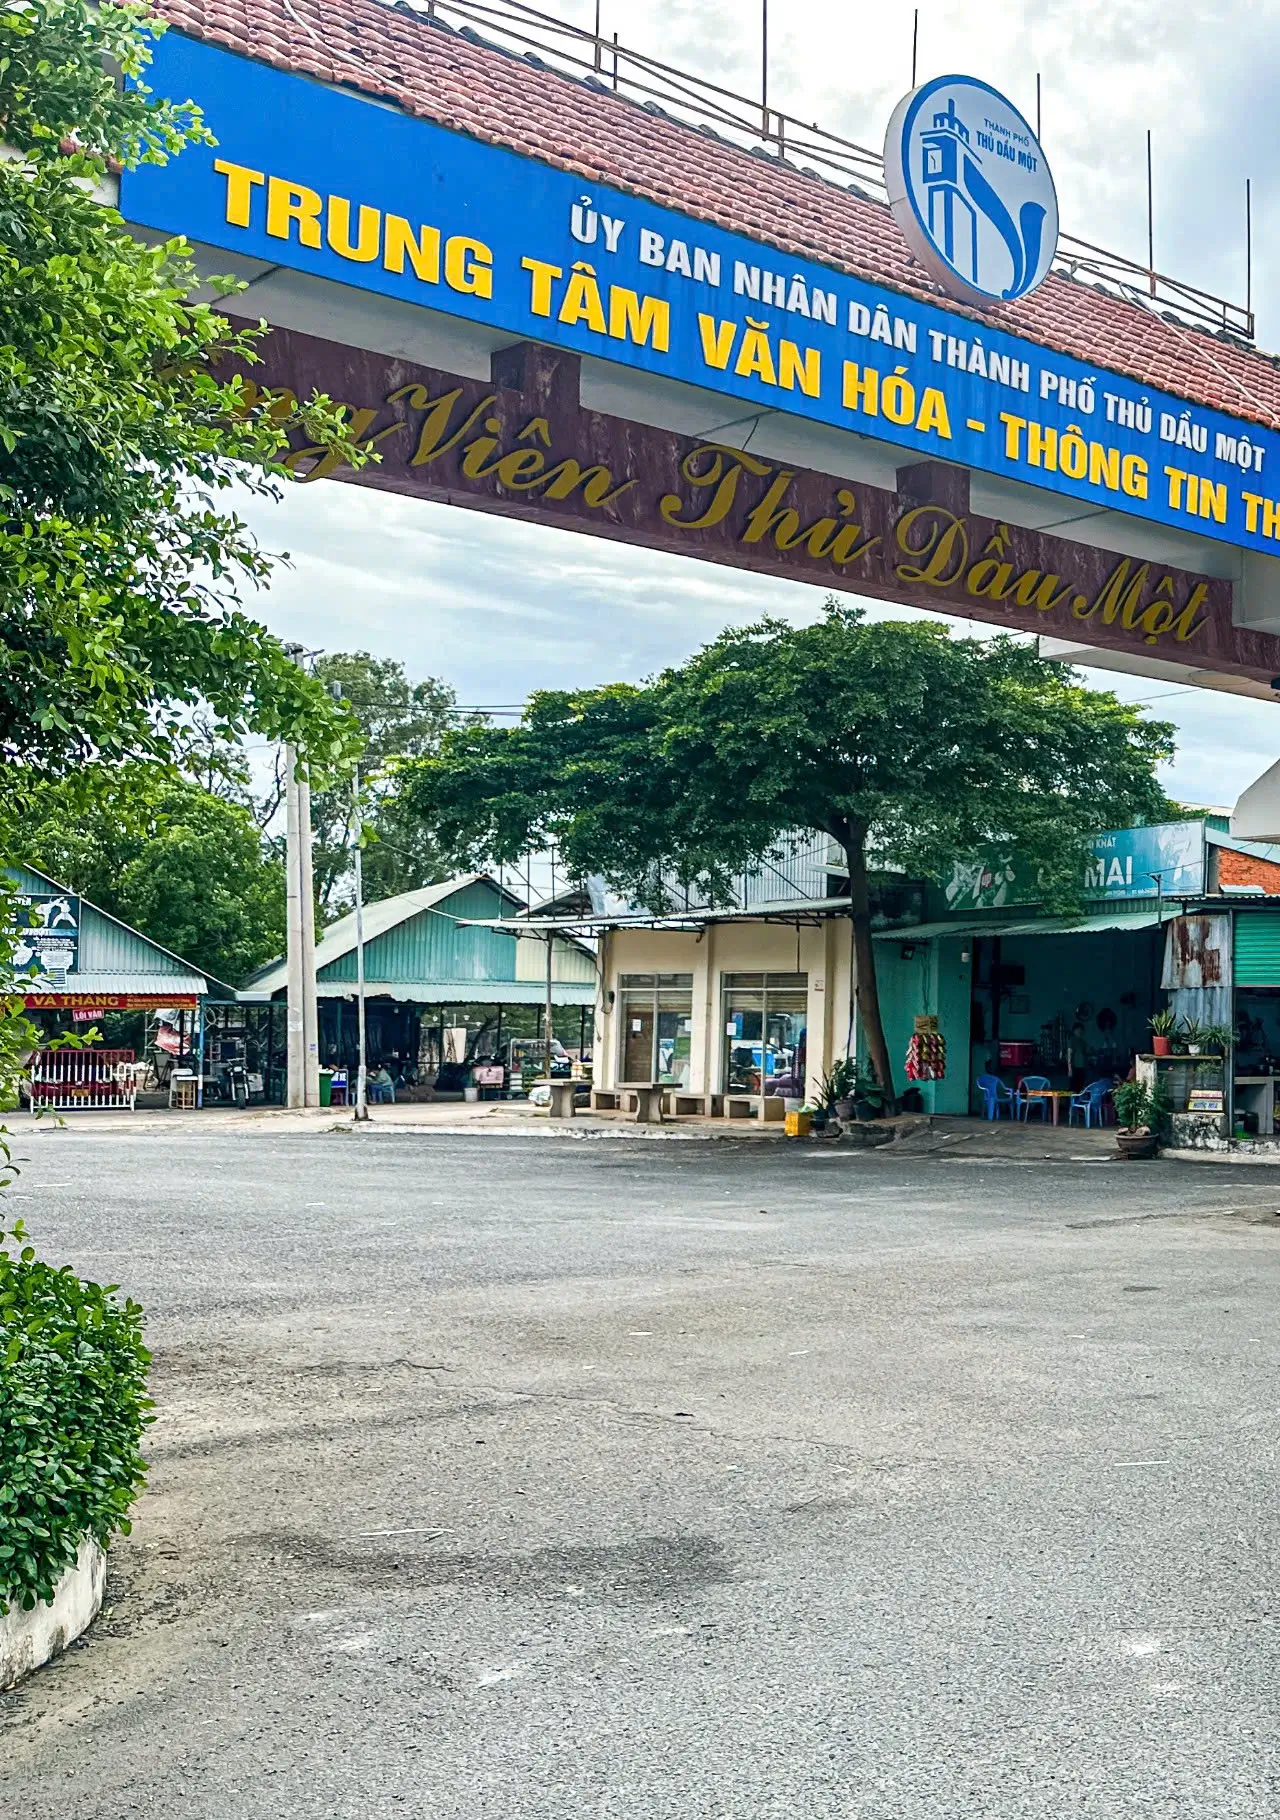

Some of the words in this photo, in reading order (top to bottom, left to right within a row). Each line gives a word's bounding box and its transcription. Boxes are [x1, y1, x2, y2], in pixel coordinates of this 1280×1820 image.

[976, 130, 994, 153] THỦ
[996, 139, 1016, 163] DẦU
[1017, 150, 1038, 174] MỘT
[983, 118, 1011, 139] THÀNH
[1012, 131, 1030, 148] PHỐ
[213, 157, 493, 300] TRUNG
[520, 255, 670, 353] TÂM
[697, 312, 821, 399] VĂN
[841, 359, 952, 440] HÓA
[999, 411, 1150, 500] THÔNG
[1163, 465, 1228, 524] TIN
[570, 195, 625, 253] ỦY
[639, 228, 721, 287] BAN
[733, 260, 838, 326] NHÂN
[848, 299, 917, 354] DÂN
[928, 329, 1030, 393] THÀNH
[1039, 368, 1098, 415] PHỐ
[1103, 391, 1152, 434] THỦ
[1159, 409, 1208, 454] DẦU
[1215, 431, 1266, 474] MỘT
[385, 381, 640, 508] Viên
[659, 443, 883, 565] Thủ
[895, 505, 1077, 611] Dầu
[1072, 557, 1214, 646] Một
[1084, 855, 1133, 888] MAI
